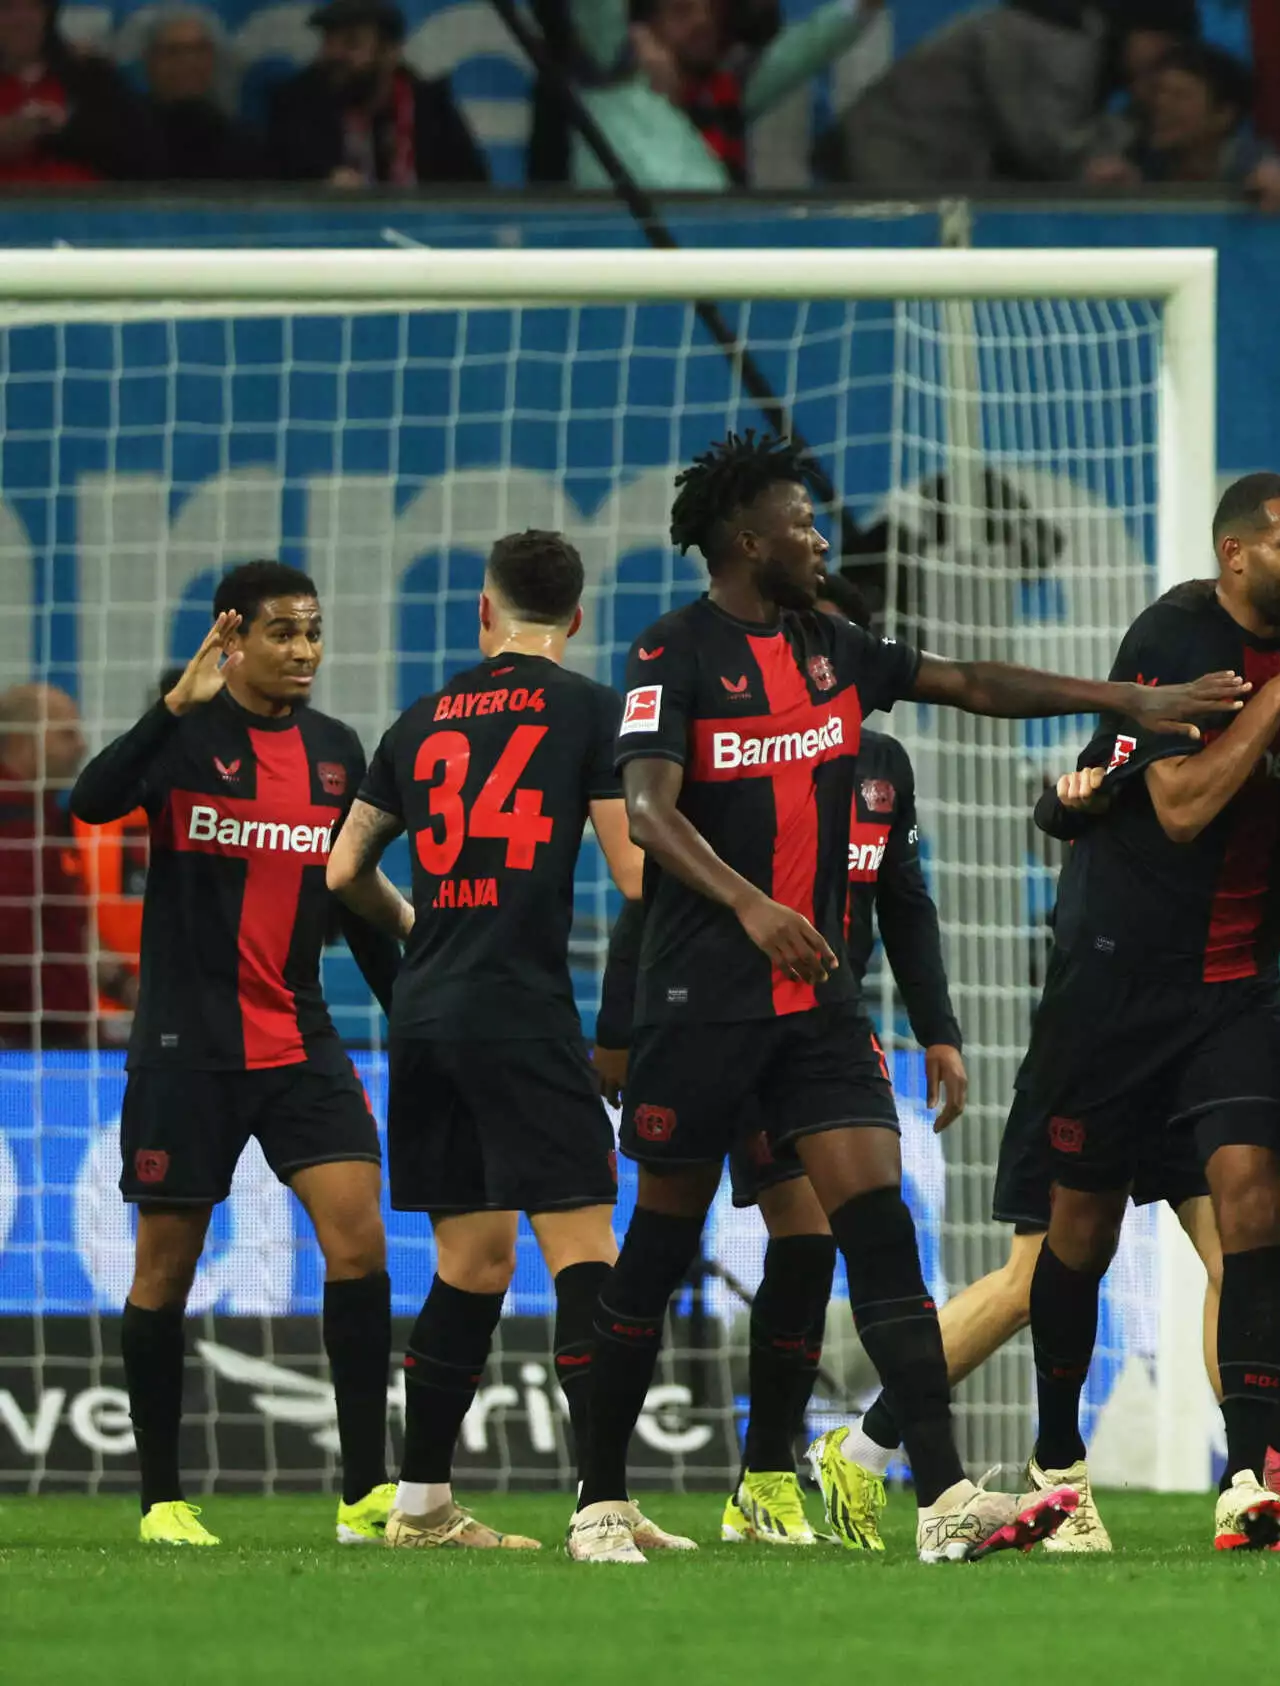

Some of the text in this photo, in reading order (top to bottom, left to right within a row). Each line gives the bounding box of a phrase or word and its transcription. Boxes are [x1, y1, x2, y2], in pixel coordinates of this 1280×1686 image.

[432, 687, 547, 722] BAYER 04
[413, 723, 554, 877] 34
